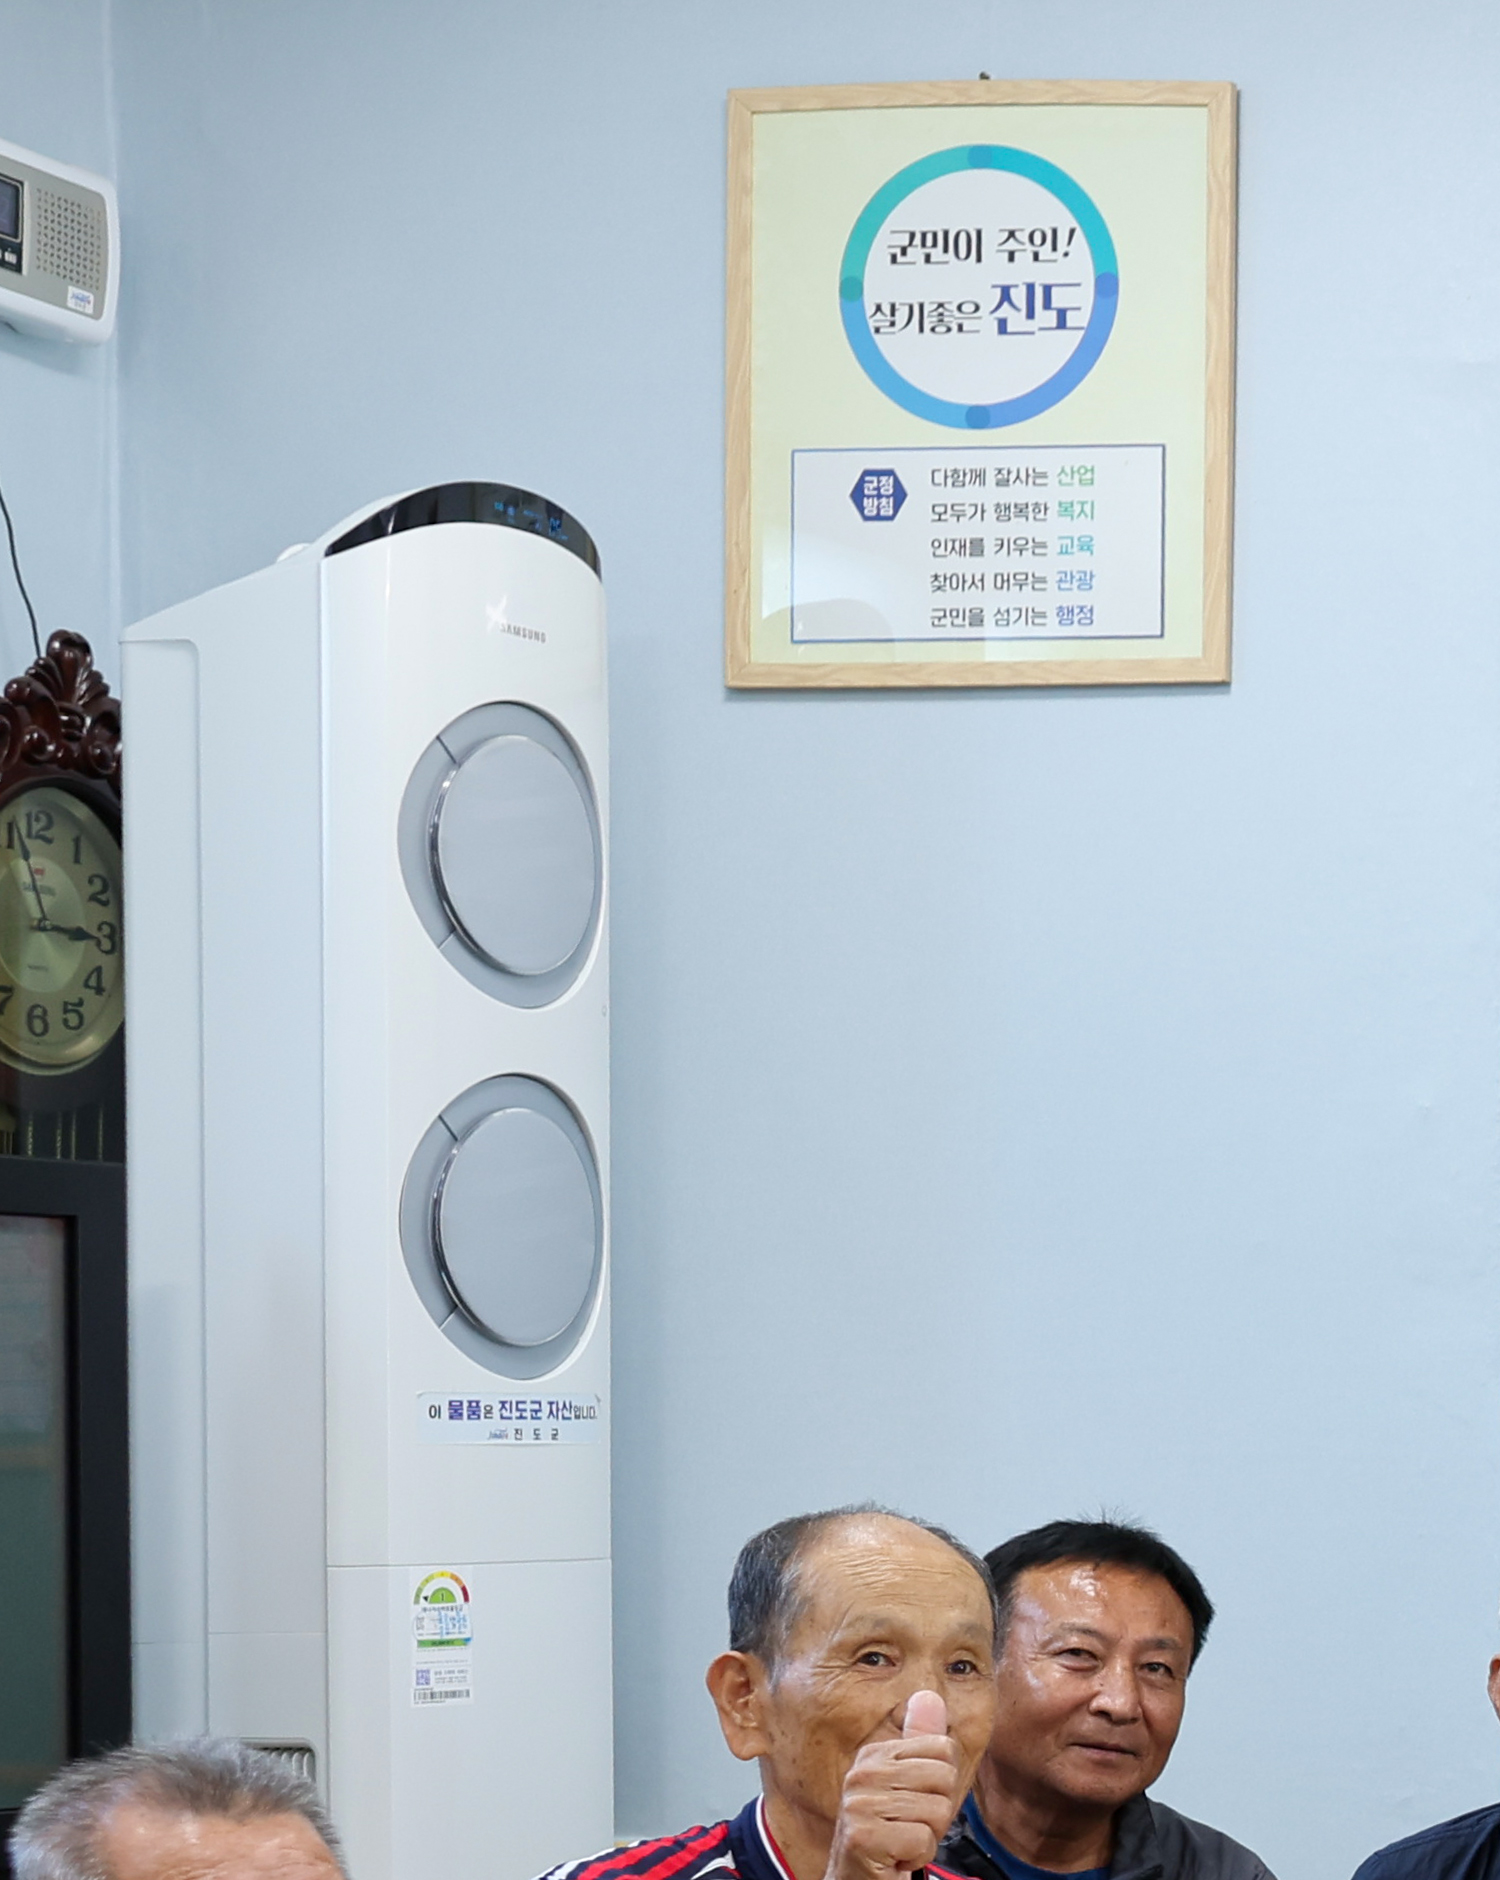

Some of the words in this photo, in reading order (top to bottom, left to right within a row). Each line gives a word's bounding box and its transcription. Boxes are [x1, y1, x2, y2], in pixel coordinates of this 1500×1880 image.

[887, 228, 983, 265] 군민이
[996, 226, 1077, 264] 주인!
[869, 300, 982, 335] 살기좋은
[989, 281, 1085, 336] 진도
[863, 476, 894, 495] 군정
[931, 467, 986, 488] 다함께
[994, 467, 1049, 488] 잘사는
[1056, 465, 1096, 487] 산업
[863, 497, 894, 517] 방침
[931, 502, 986, 523] 모두가
[994, 501, 1049, 523] 행복한
[1056, 500, 1096, 521] 복지
[931, 537, 985, 559] 인재를
[994, 536, 1048, 557] 키우는
[1056, 535, 1096, 556] 교육
[930, 572, 986, 593] 찾아서
[993, 572, 1048, 592] 머무는
[1055, 570, 1096, 592] 관광
[930, 607, 985, 628] 군민을
[993, 606, 1048, 627] 섬기는
[1055, 605, 1095, 627] 행정
[500, 623, 546, 643] SAMSUNG
[26, 810, 54, 844] 12
[72, 835, 82, 864] 1
[88, 874, 110, 906] 2
[97, 921, 118, 954] 3
[83, 966, 106, 996] 4
[26, 1004, 49, 1037] 6
[62, 998, 84, 1030] 5
[428, 1404, 441, 1419] 이
[448, 1400, 493, 1421] 물품은
[498, 1400, 542, 1420] 진도군
